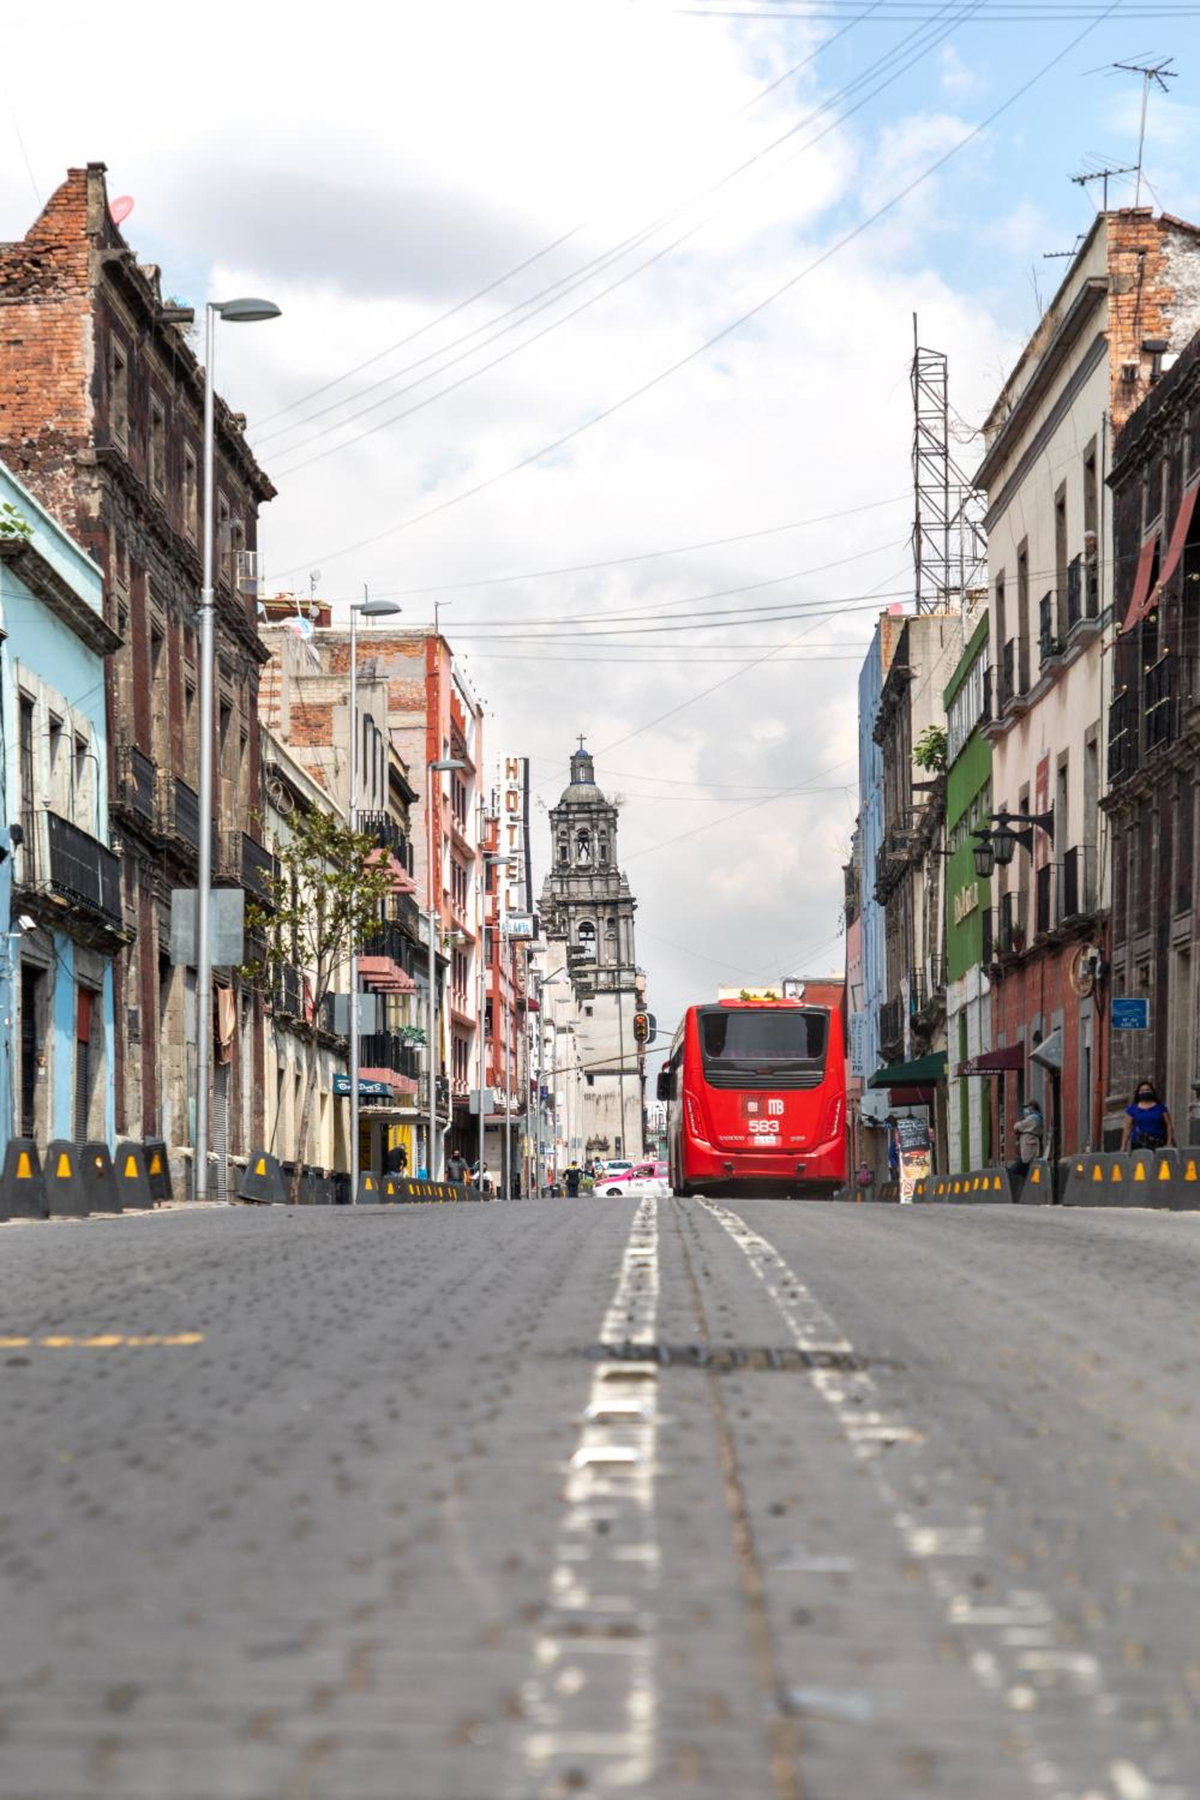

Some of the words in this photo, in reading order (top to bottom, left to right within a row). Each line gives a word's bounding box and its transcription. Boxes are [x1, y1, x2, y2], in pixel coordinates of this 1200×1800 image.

[505, 757, 518, 912] HOTEL
[768, 1099, 784, 1115] MB
[748, 1120, 780, 1132] 583
